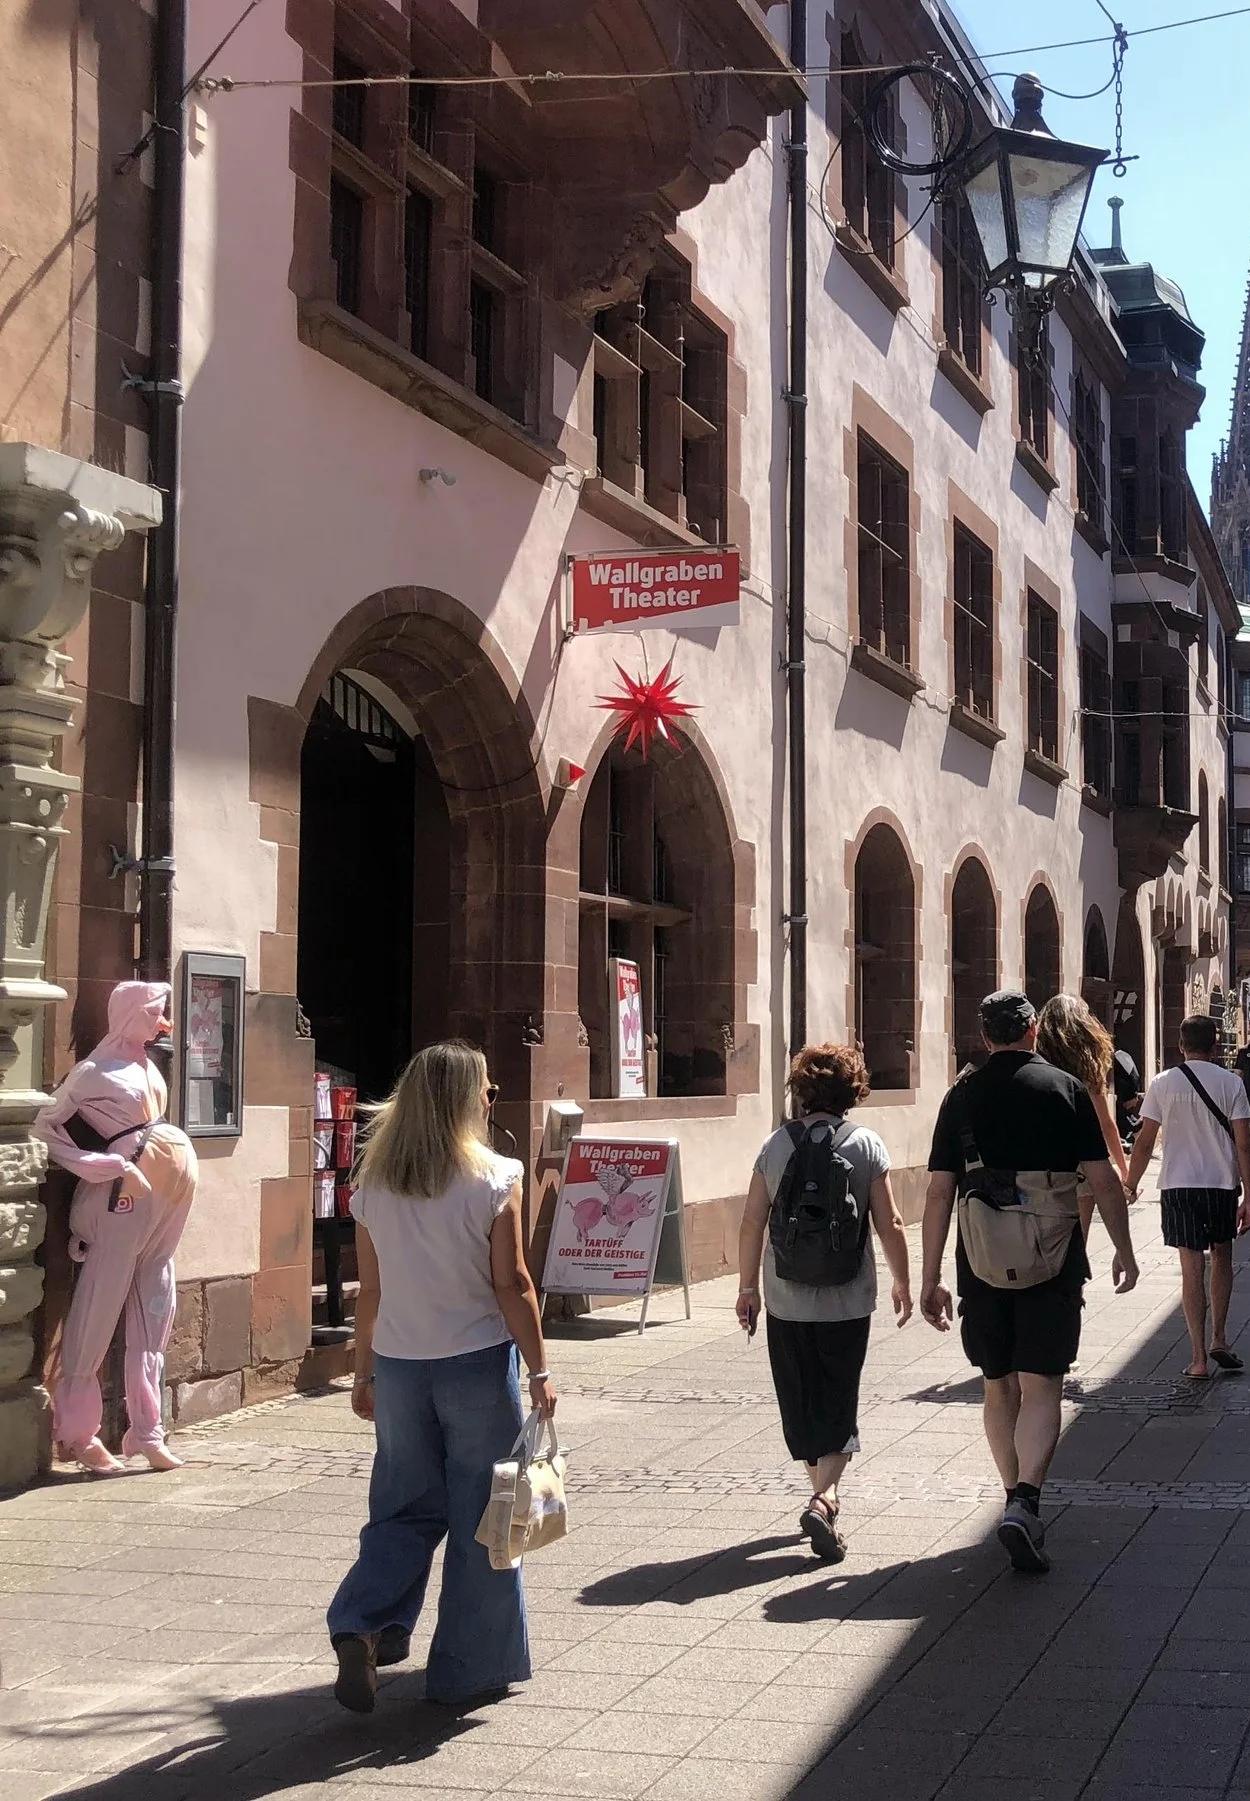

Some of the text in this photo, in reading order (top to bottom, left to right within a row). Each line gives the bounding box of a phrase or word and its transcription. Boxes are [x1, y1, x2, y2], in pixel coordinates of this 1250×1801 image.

[588, 559, 723, 588] Wallgraben
[609, 587, 701, 609] Theater
[579, 1145, 661, 1163] Wallgraben
[584, 1237, 624, 1248] TARTÜFF
[558, 1248, 646, 1260] ODER DER GEISTIGE
